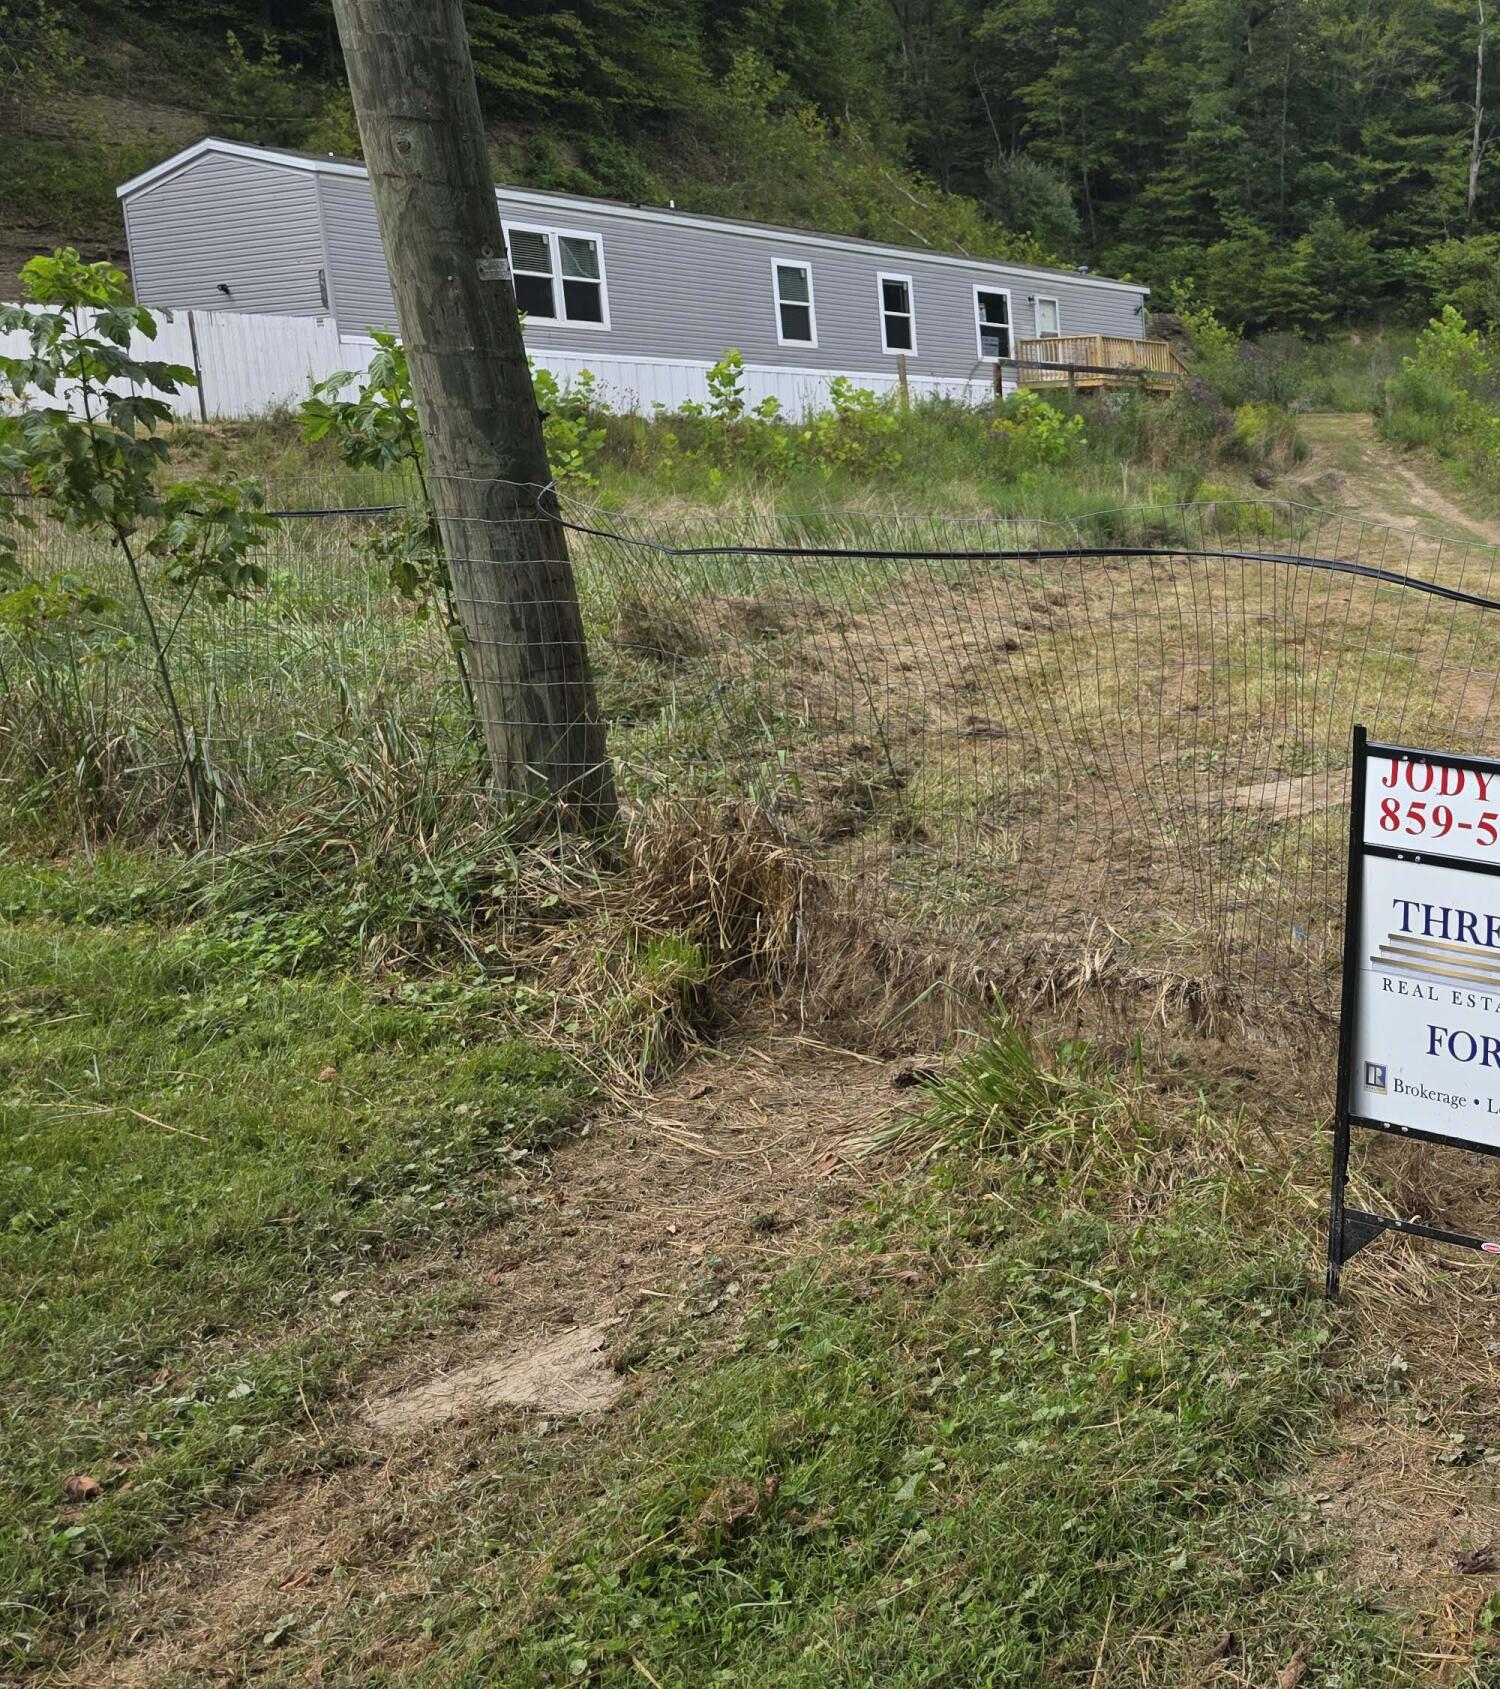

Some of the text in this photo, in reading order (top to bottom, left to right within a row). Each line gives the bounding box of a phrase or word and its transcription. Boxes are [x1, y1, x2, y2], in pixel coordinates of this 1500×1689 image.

[1382, 759, 1494, 801] JODY
[1382, 977, 1439, 1001] REAL
[1393, 1078, 1467, 1109] Brokerage
